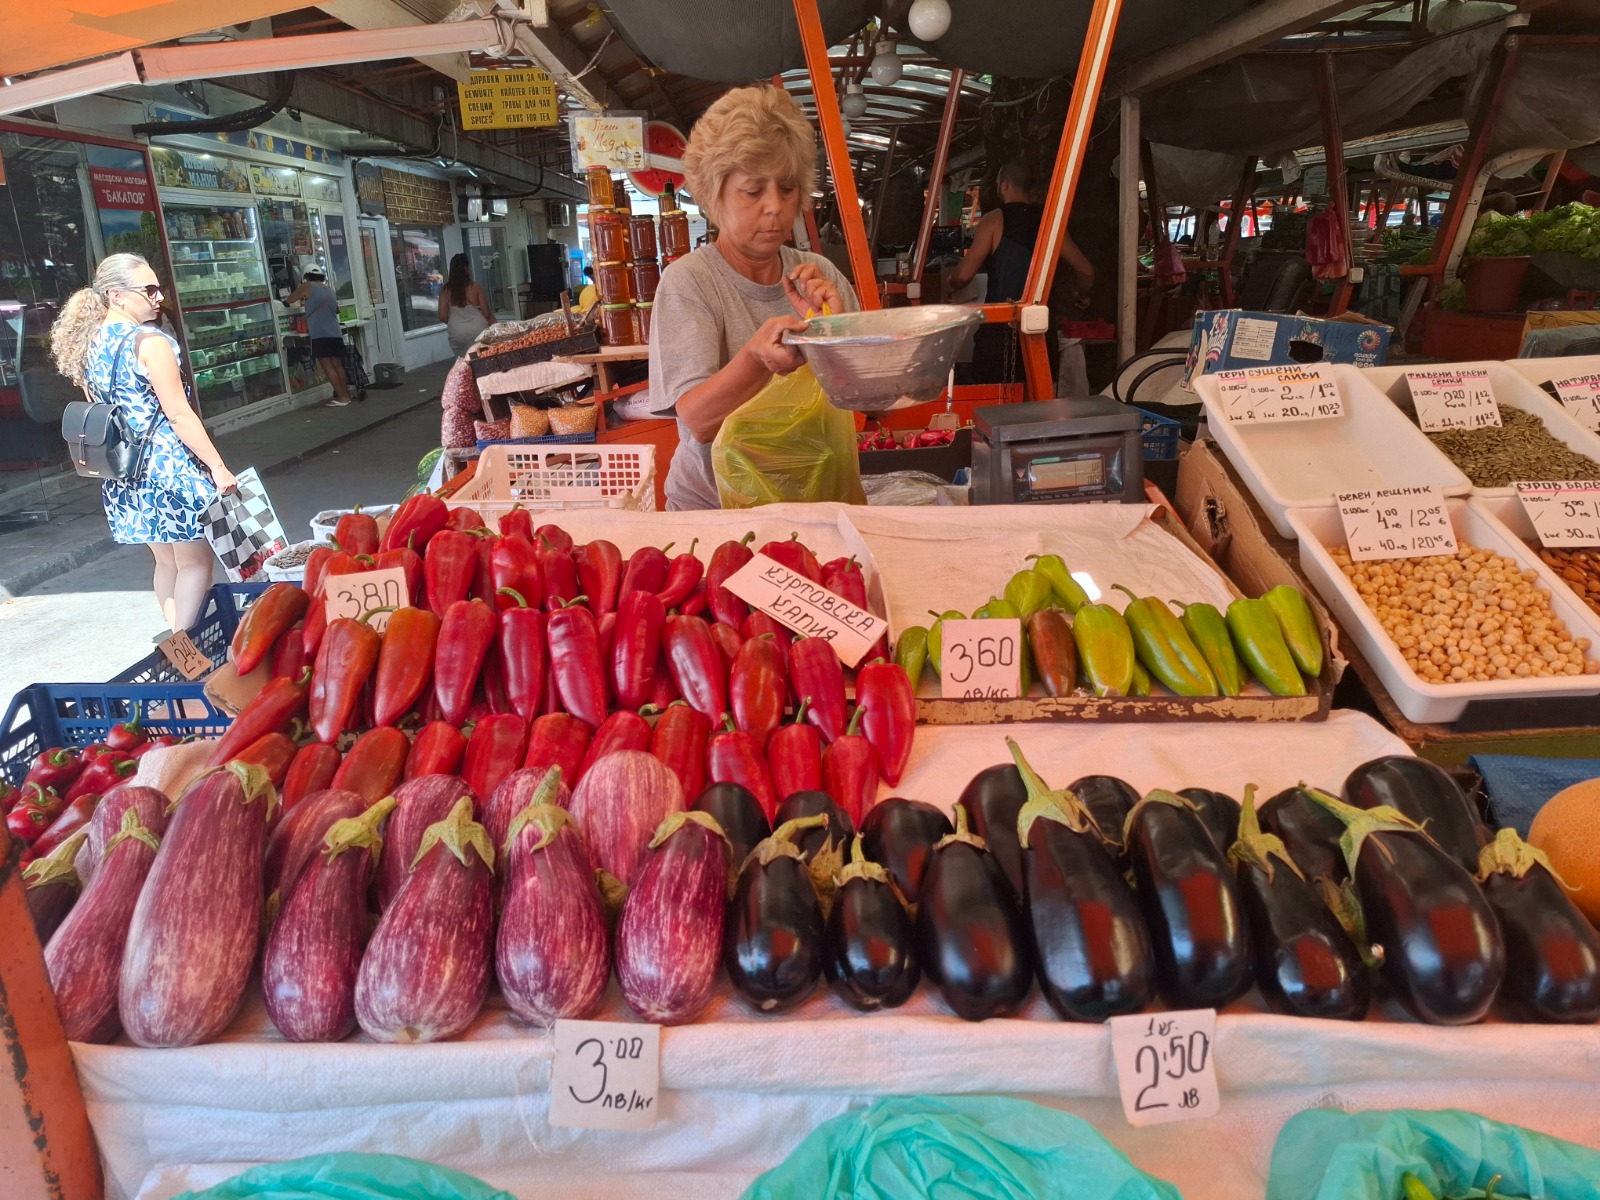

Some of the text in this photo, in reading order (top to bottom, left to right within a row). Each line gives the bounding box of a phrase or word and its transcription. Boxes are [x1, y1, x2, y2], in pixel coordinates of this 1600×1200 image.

[462, 74, 500, 86] ДПРАВКИ
[526, 73, 535, 82] ЗА
[464, 88, 494, 99] GEWÜRZE
[500, 85, 551, 97] KRÄUTER FÜR TEE
[471, 115, 493, 125] SPICES
[505, 113, 551, 123] HERBS FOR TEA
[1248, 366, 1302, 377] СУШЕНИ
[1278, 371, 1320, 381] СЛИВИ
[1516, 482, 1562, 490] СУРОВ
[1338, 486, 1432, 502] БЕЛЕН ЛЕШНИК
[764, 566, 875, 632] КУРТОВСКА
[768, 594, 839, 642] КАПИЯ
